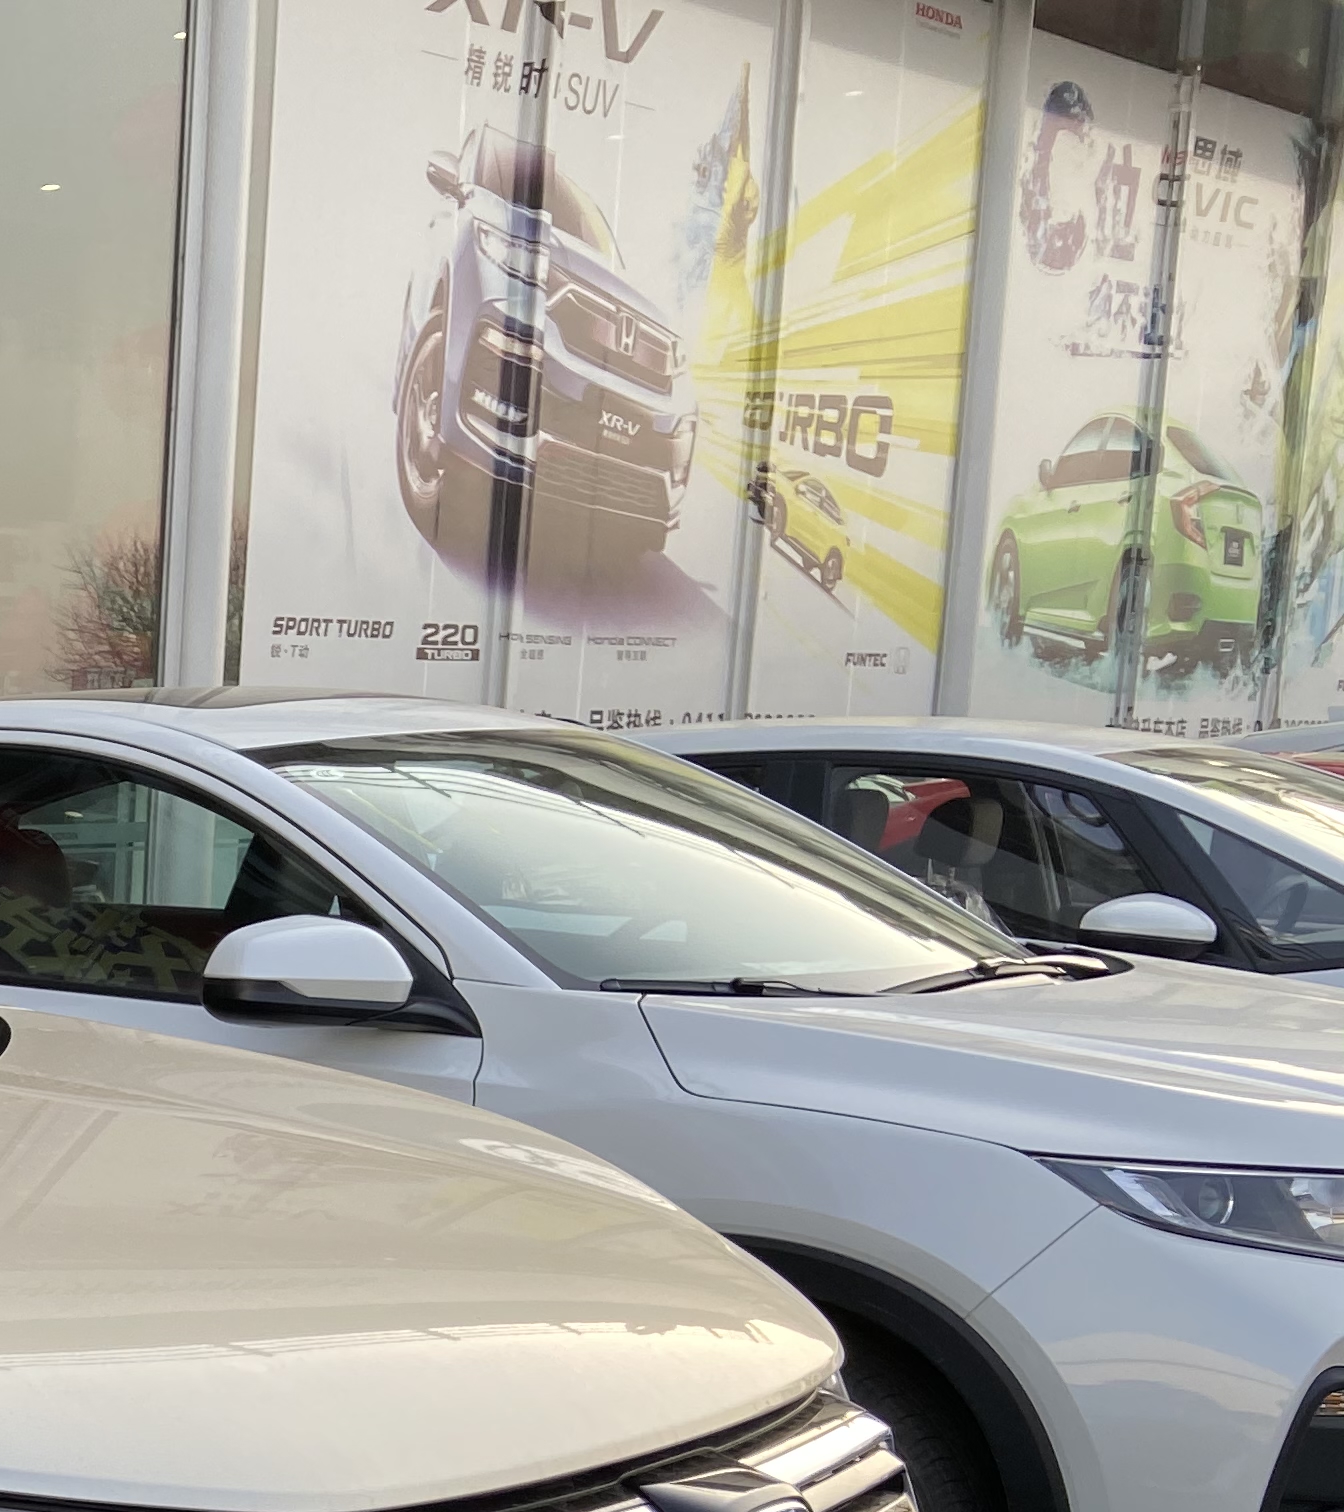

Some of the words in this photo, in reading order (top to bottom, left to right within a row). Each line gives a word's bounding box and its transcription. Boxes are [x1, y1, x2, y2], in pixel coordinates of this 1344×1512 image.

[915, 2, 963, 30] HONDA
[1152, 172, 1259, 230] CVIC
[598, 409, 642, 437] XR-V
[271, 616, 333, 637] SPORT
[335, 619, 395, 639] TURBO
[420, 622, 479, 647] 220
[426, 648, 474, 661] TURBO
[845, 652, 888, 667] FUNTEC
